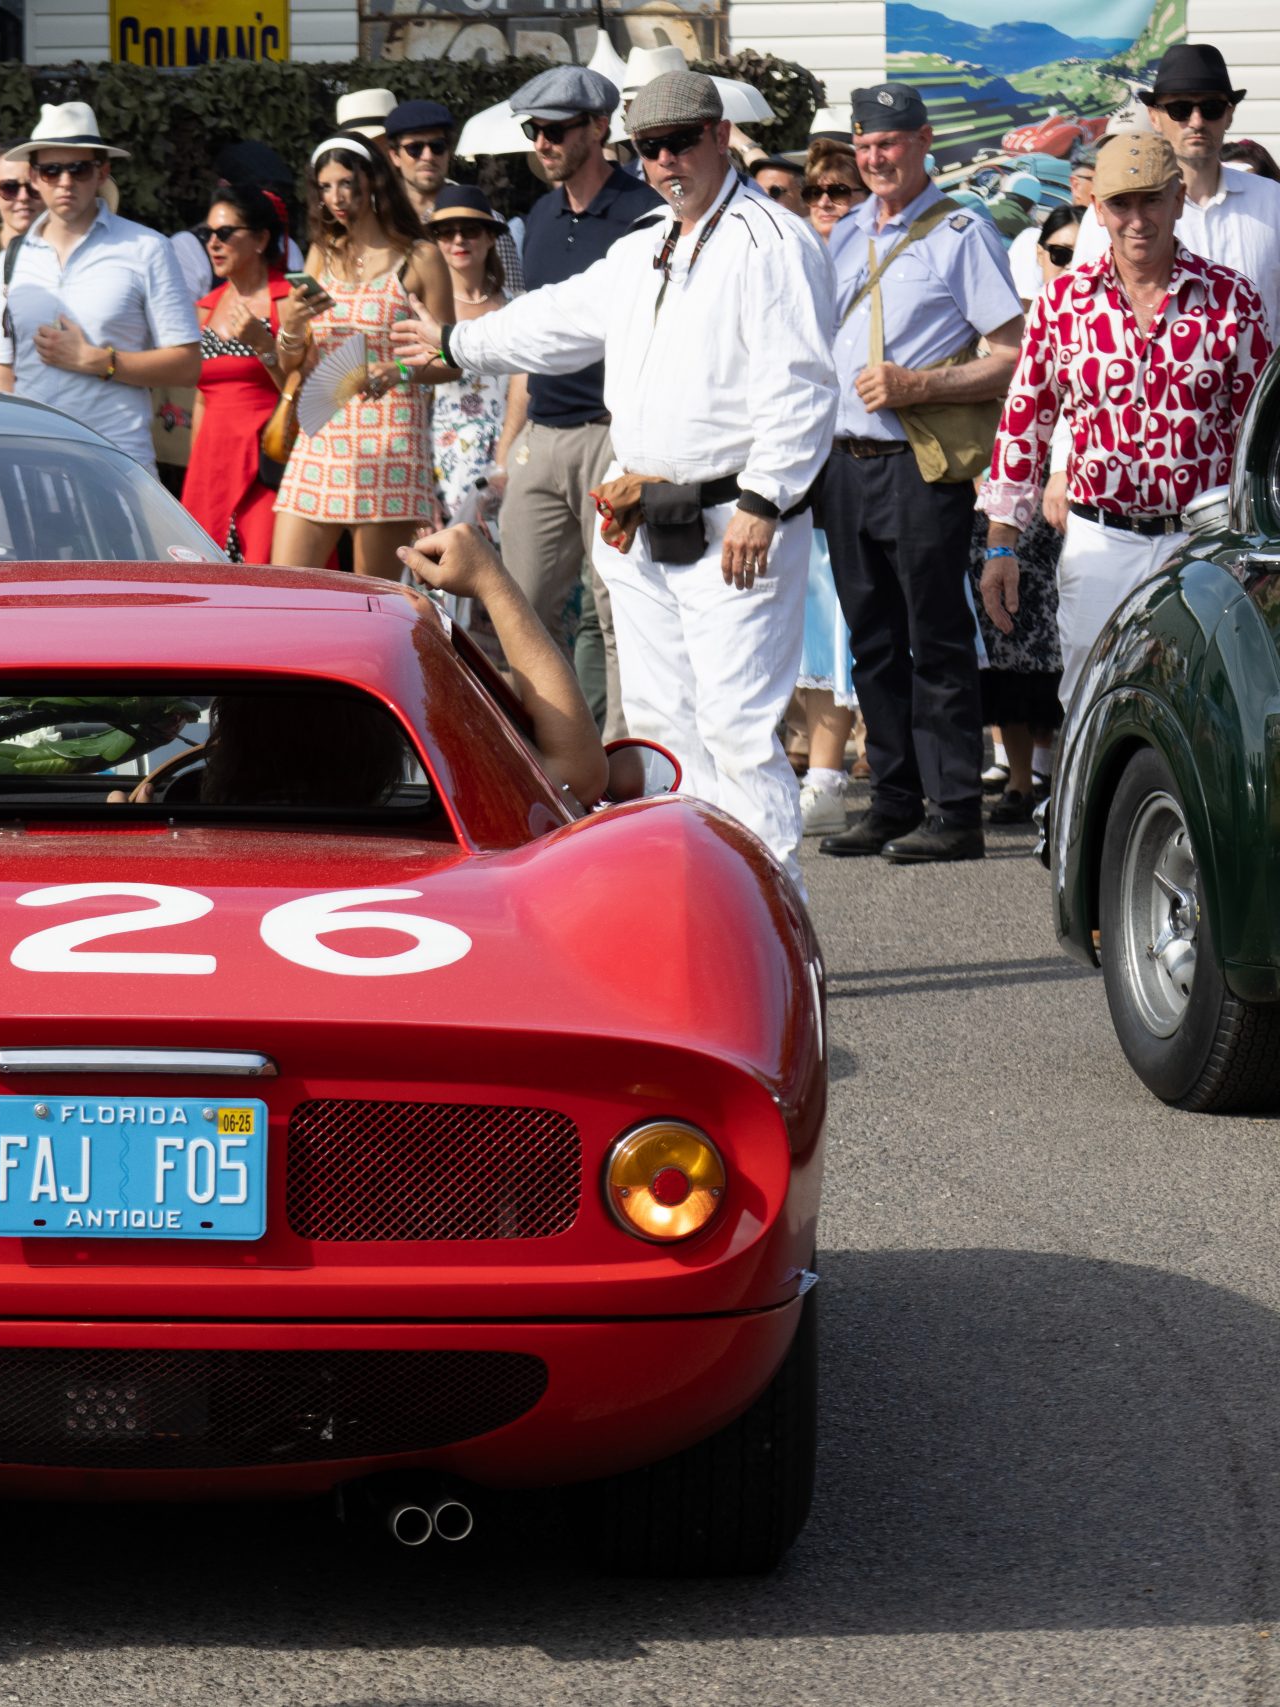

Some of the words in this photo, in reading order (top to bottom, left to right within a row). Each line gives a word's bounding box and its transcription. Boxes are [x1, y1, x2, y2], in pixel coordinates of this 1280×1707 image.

[60, 1105, 189, 1125] FLORIDA
[223, 1114, 251, 1132] 06-25
[65, 1209, 183, 1229] ANTIQUE
